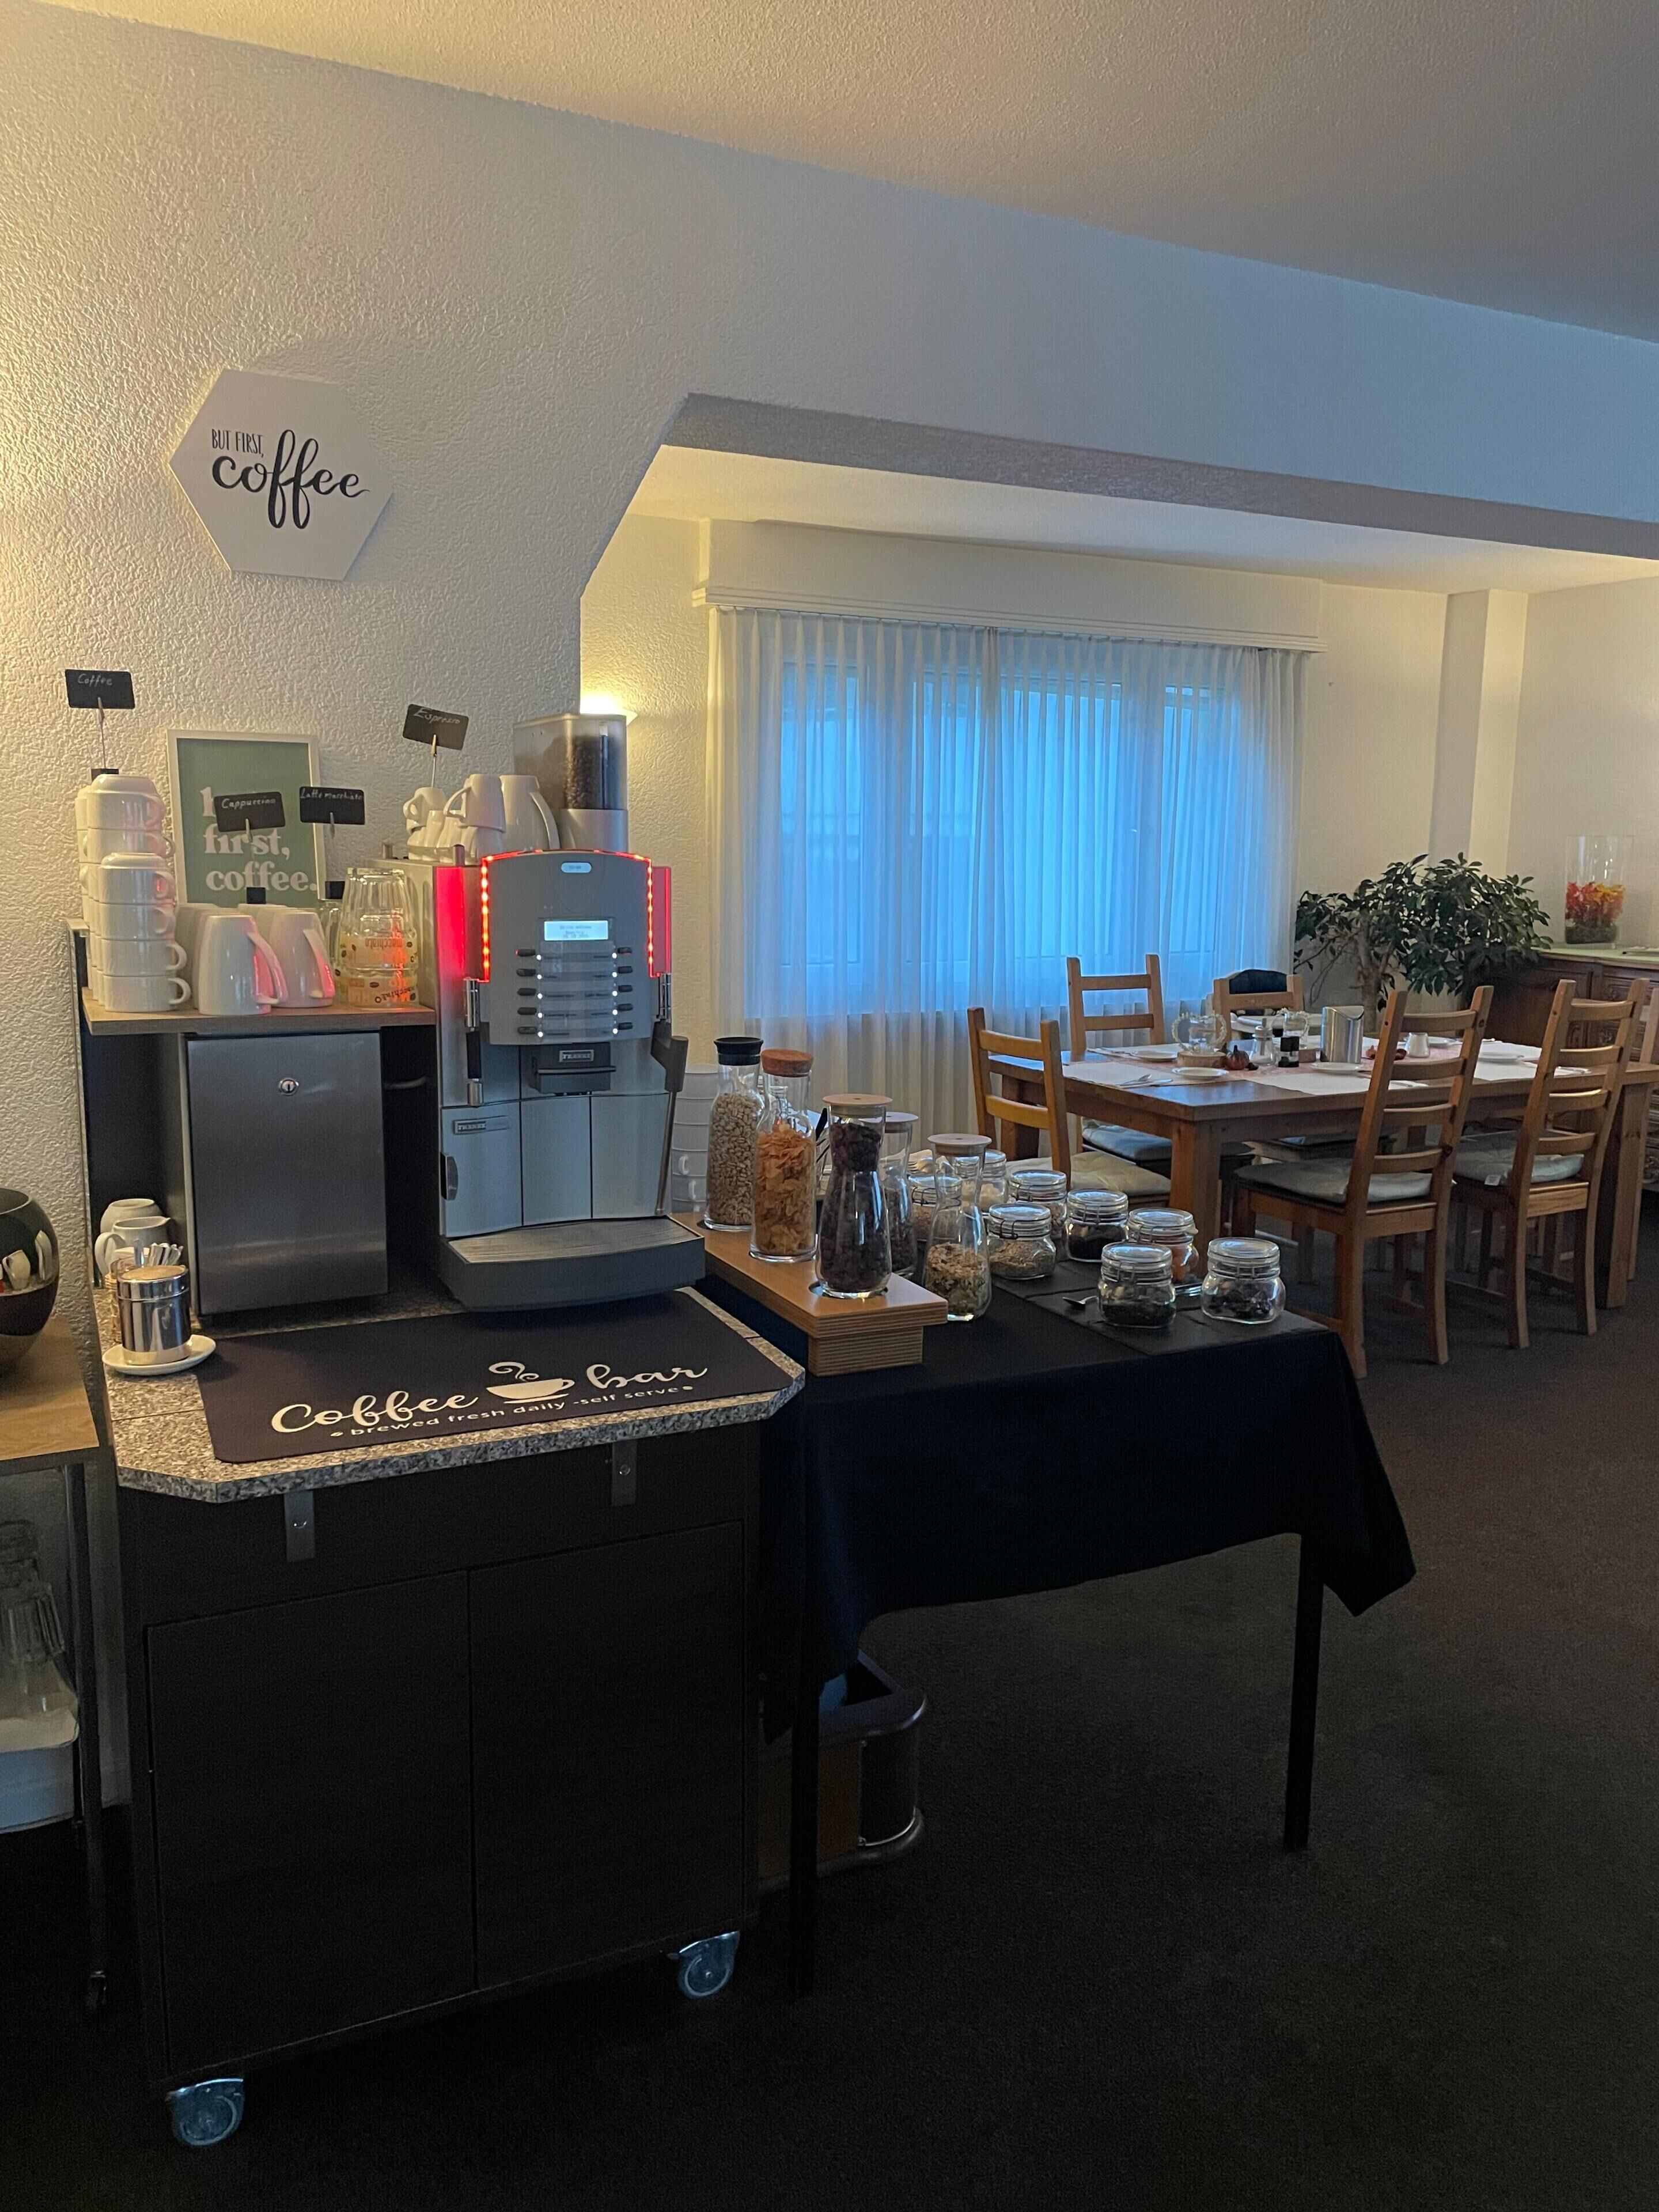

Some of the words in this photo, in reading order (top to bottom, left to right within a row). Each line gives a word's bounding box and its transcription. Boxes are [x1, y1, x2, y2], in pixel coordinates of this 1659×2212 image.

[211, 429, 230, 450] BUT
[235, 431, 264, 458] FIRST,
[212, 429, 370, 529] coffee
[78, 673, 112, 687] Coffee
[413, 707, 461, 724] Espresso
[221, 796, 276, 810] Cappuccino
[300, 787, 322, 798] Latte
[203, 823, 290, 861] first,
[205, 861, 317, 892] coffee.
[271, 1390, 479, 1433] Coffee
[586, 1363, 708, 1389] bar
[351, 1418, 440, 1435] brewed
[448, 1409, 505, 1423] fresh
[513, 1402, 565, 1415] daily
[624, 1386, 679, 1399] serve
